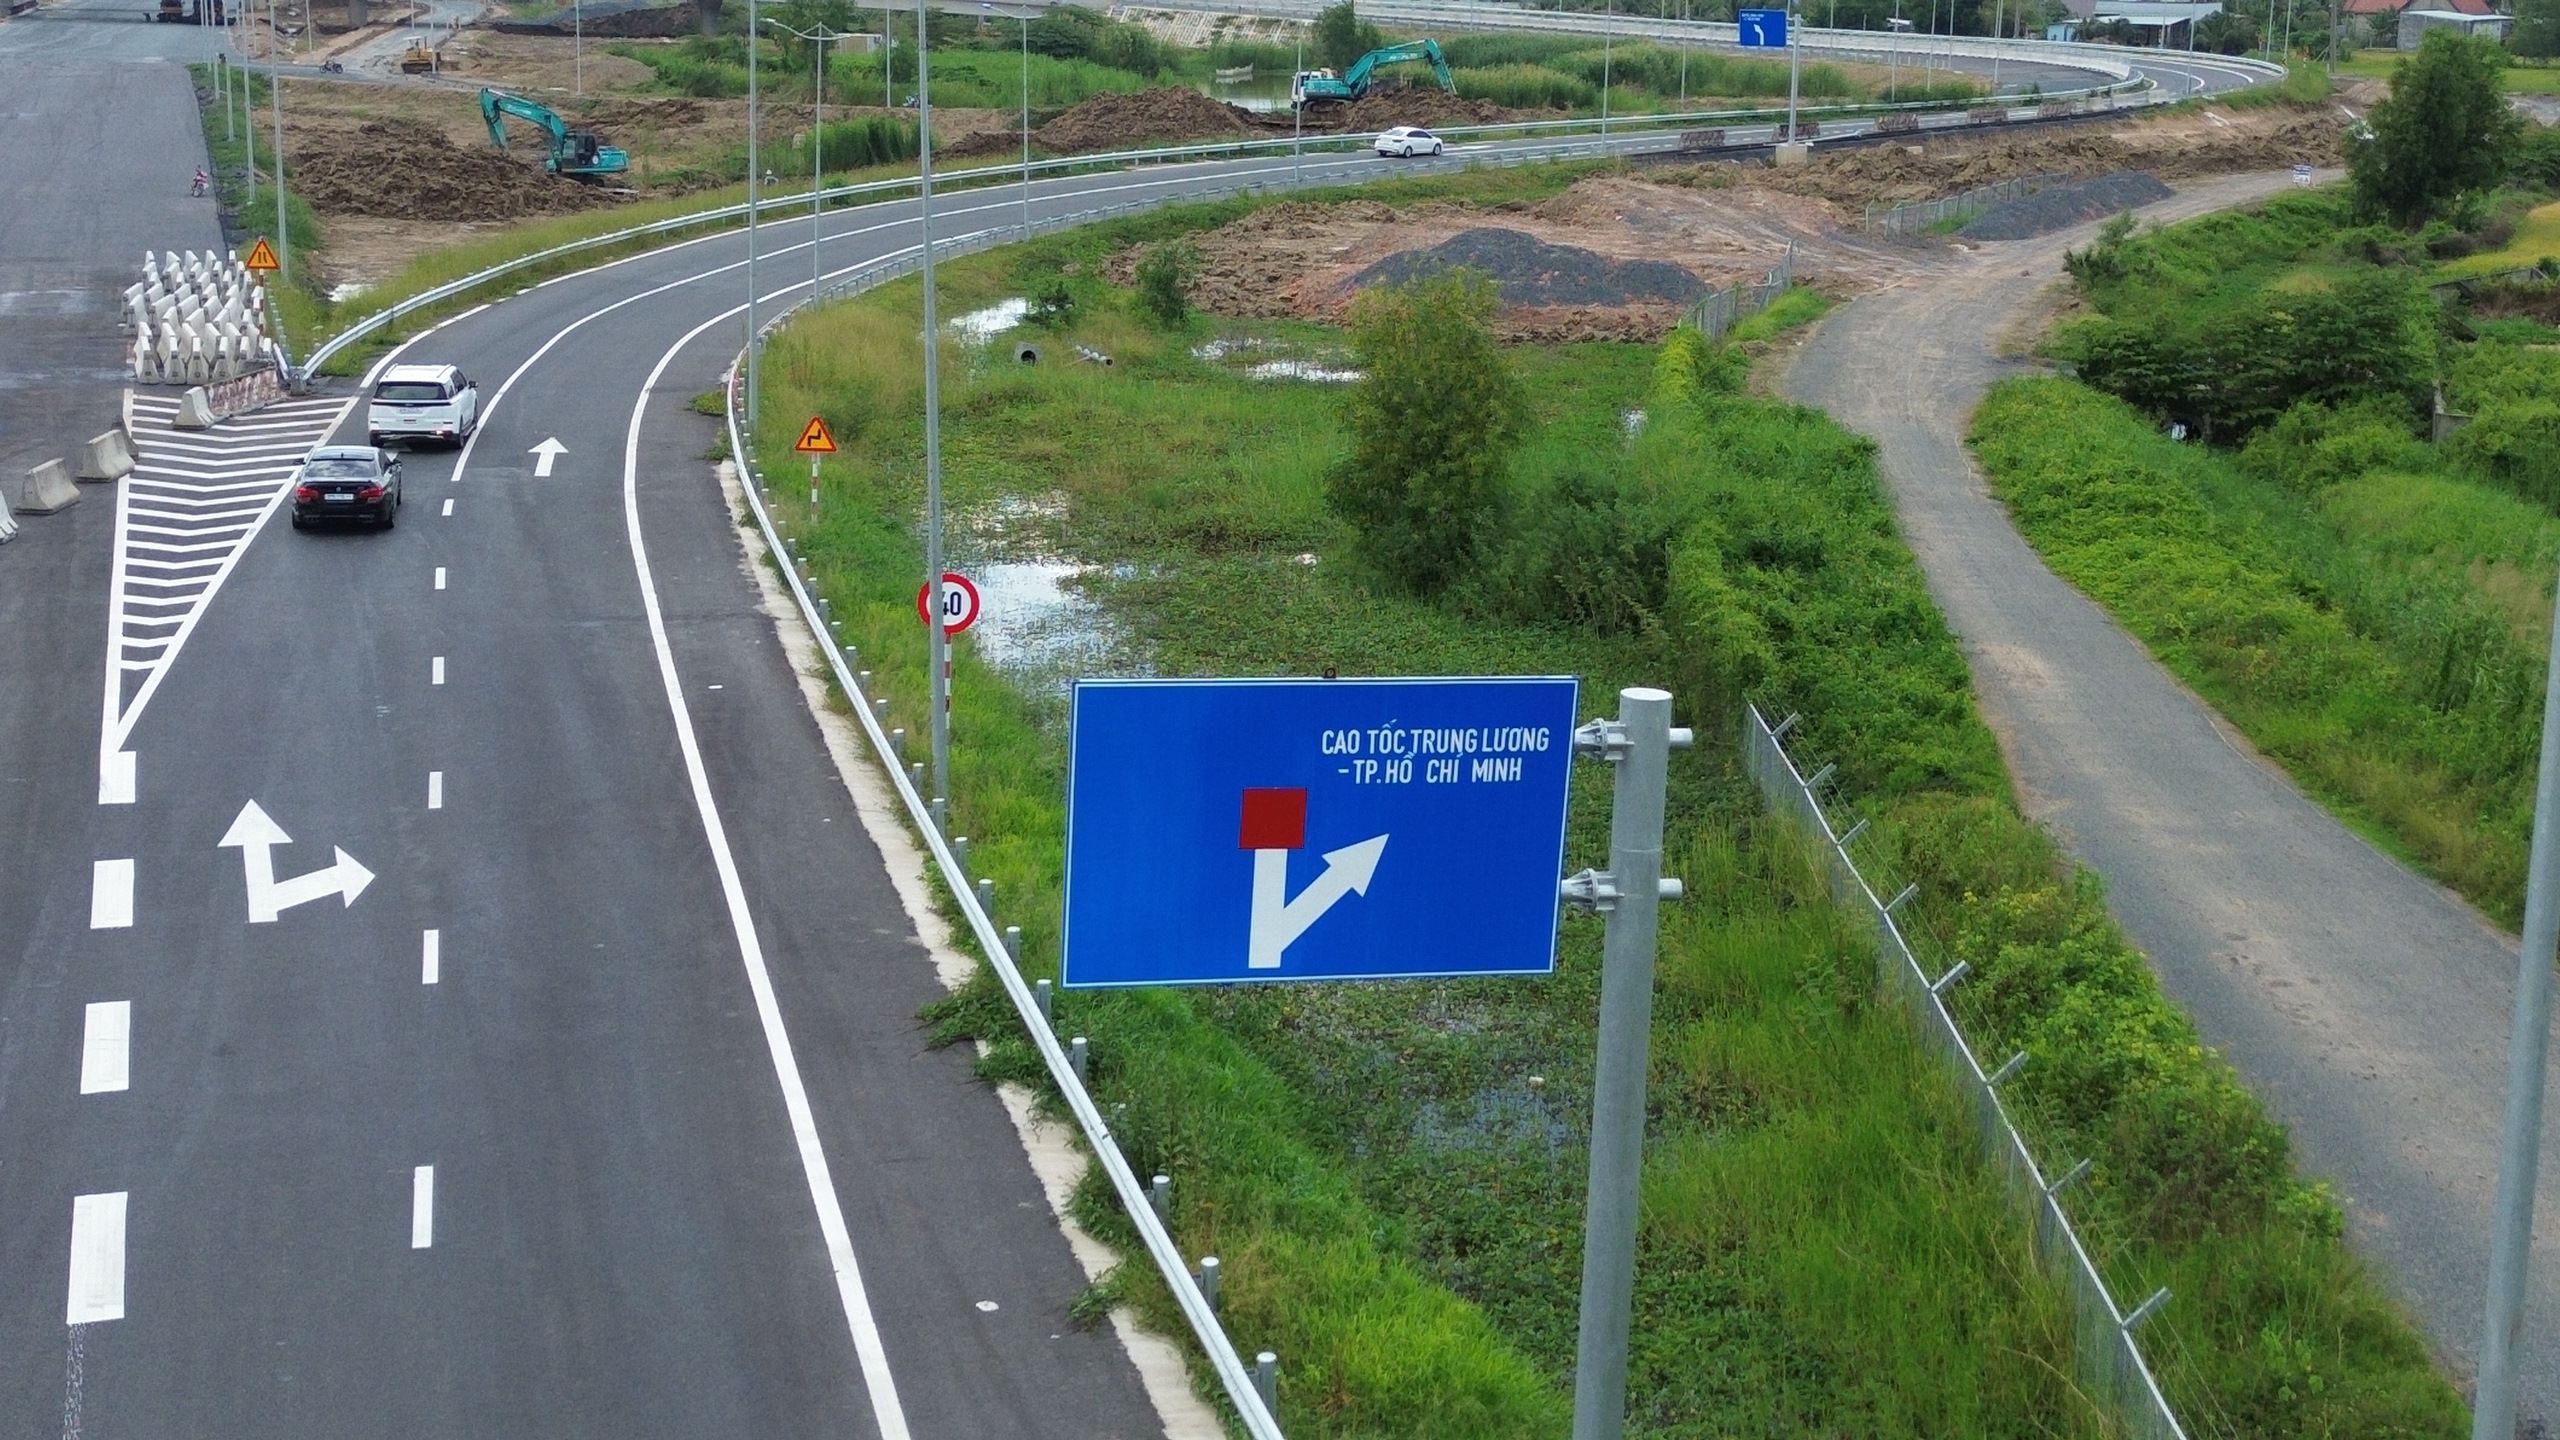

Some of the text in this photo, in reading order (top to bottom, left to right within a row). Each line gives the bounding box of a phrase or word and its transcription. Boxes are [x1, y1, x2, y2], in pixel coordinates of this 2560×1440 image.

[1321, 718, 1550, 755] CAO TỐC TRUNG LƯƠNG
[1426, 751, 1464, 784] CHÍ
[1471, 757, 1523, 783] MINH
